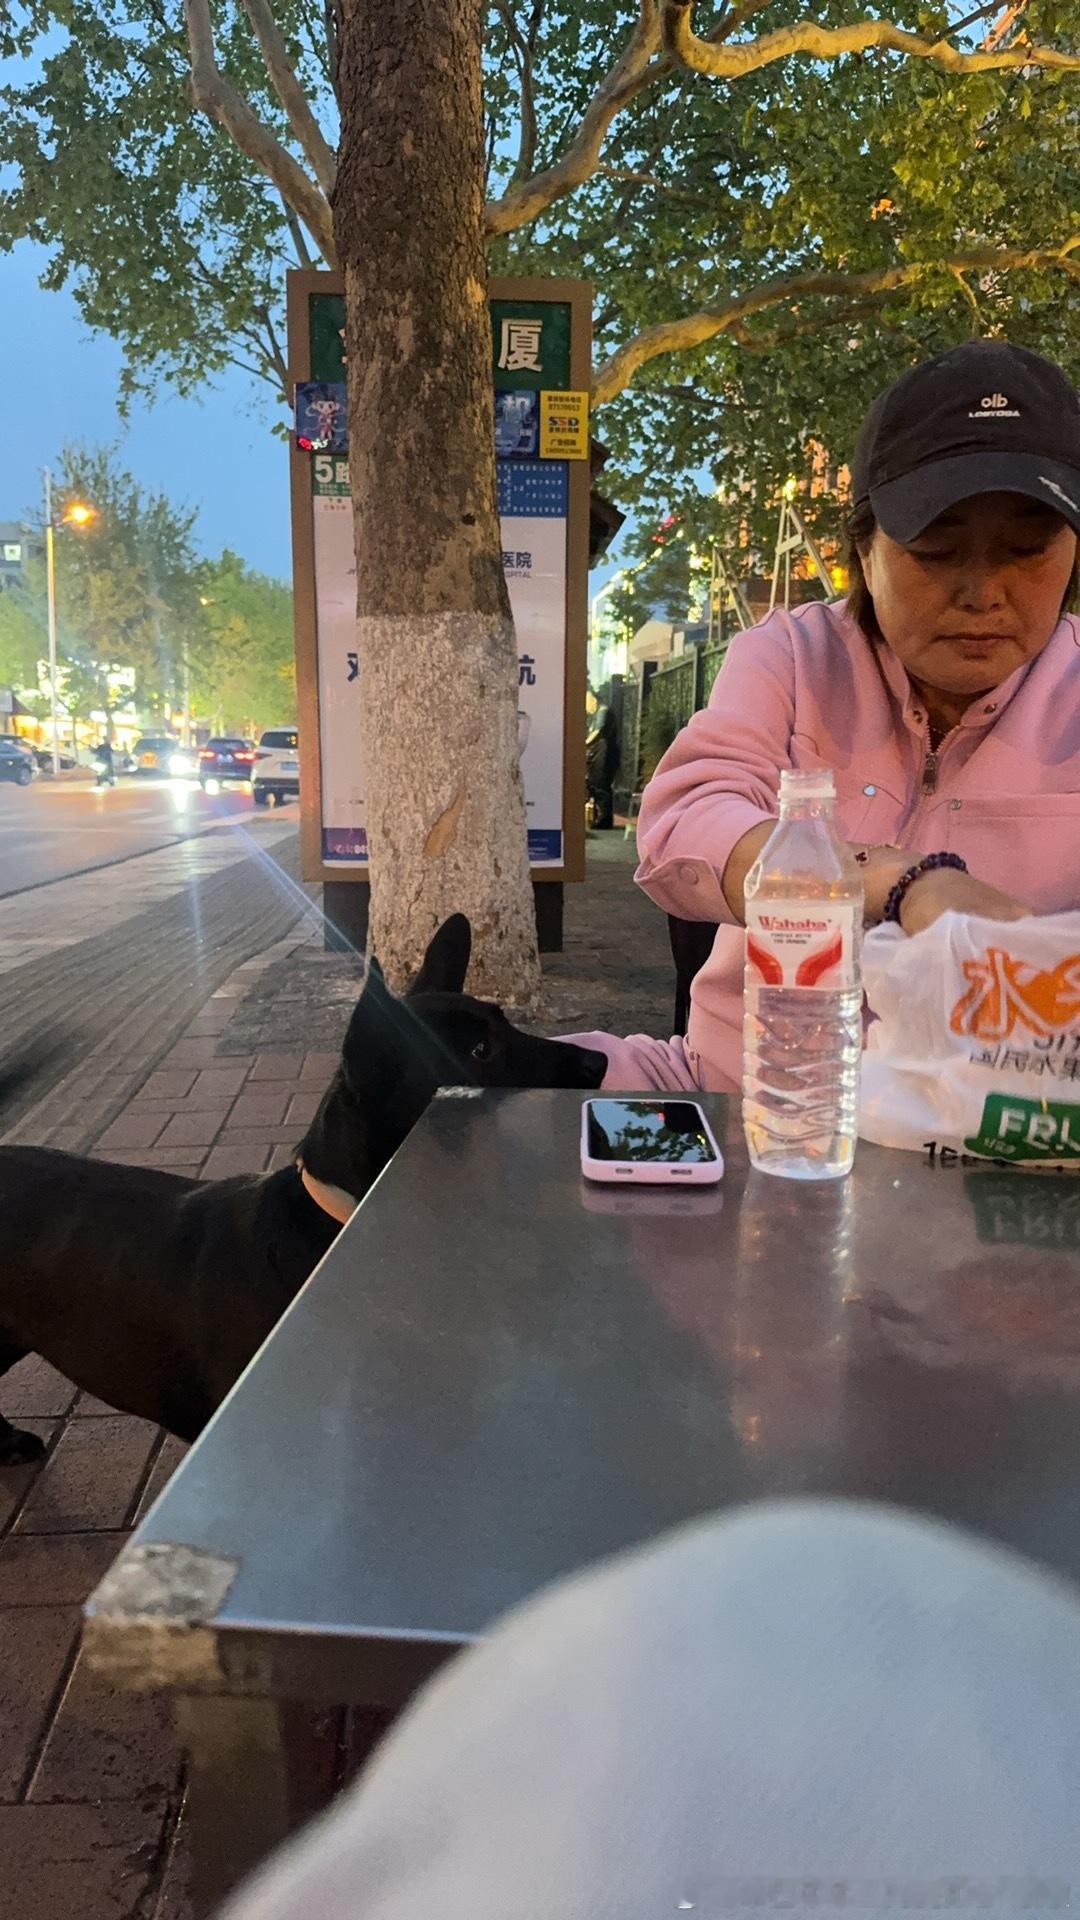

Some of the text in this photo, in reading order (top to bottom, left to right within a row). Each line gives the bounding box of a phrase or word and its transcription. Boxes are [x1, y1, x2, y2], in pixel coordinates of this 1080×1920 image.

[497, 318, 544, 373] 厦
[548, 416, 580, 427] SSD
[502, 551, 532, 569] 医院
